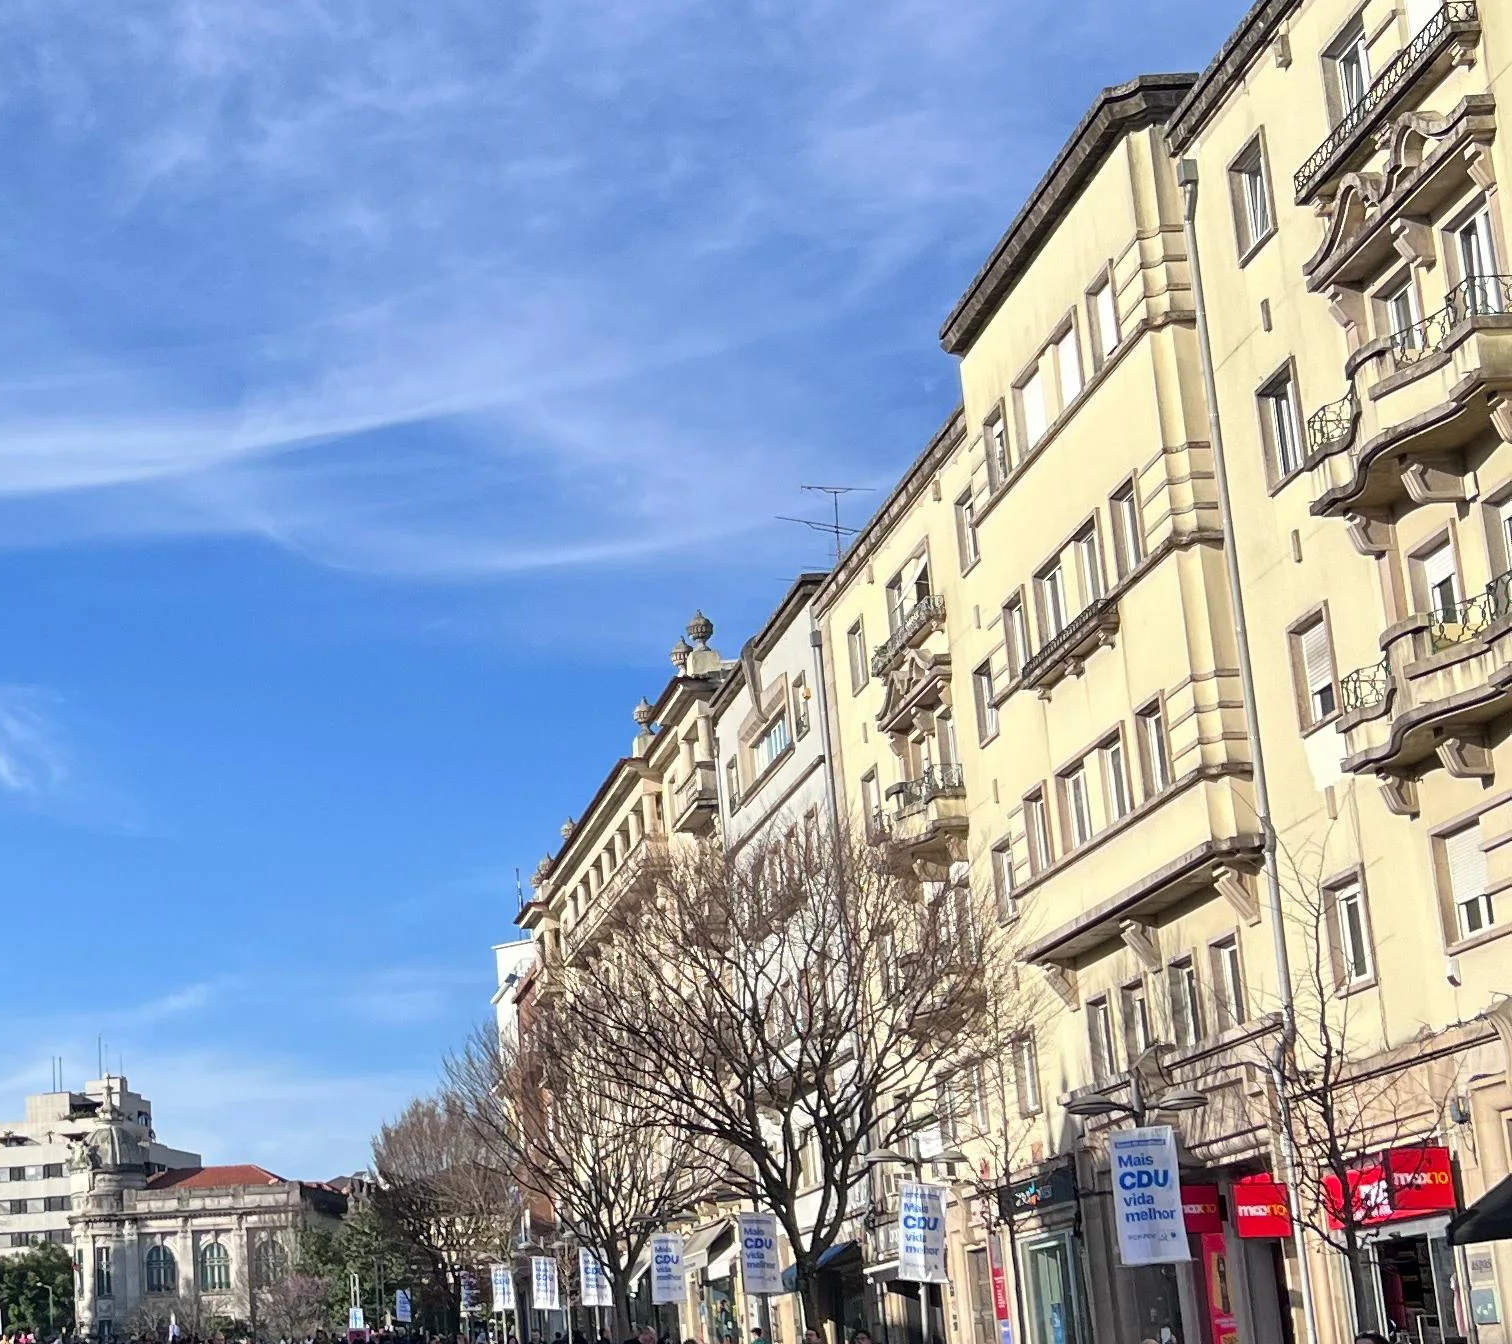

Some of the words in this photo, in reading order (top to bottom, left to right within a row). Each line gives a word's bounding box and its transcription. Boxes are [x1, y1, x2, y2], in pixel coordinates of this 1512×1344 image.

[1118, 1153, 1154, 1169] Mais
[1119, 1169, 1169, 1191] CDU
[1123, 1192, 1155, 1207] vida
[903, 1215, 939, 1231] CDU
[1125, 1207, 1176, 1223] melhor
[744, 1238, 773, 1249] CDU
[654, 1255, 679, 1264] CDU
